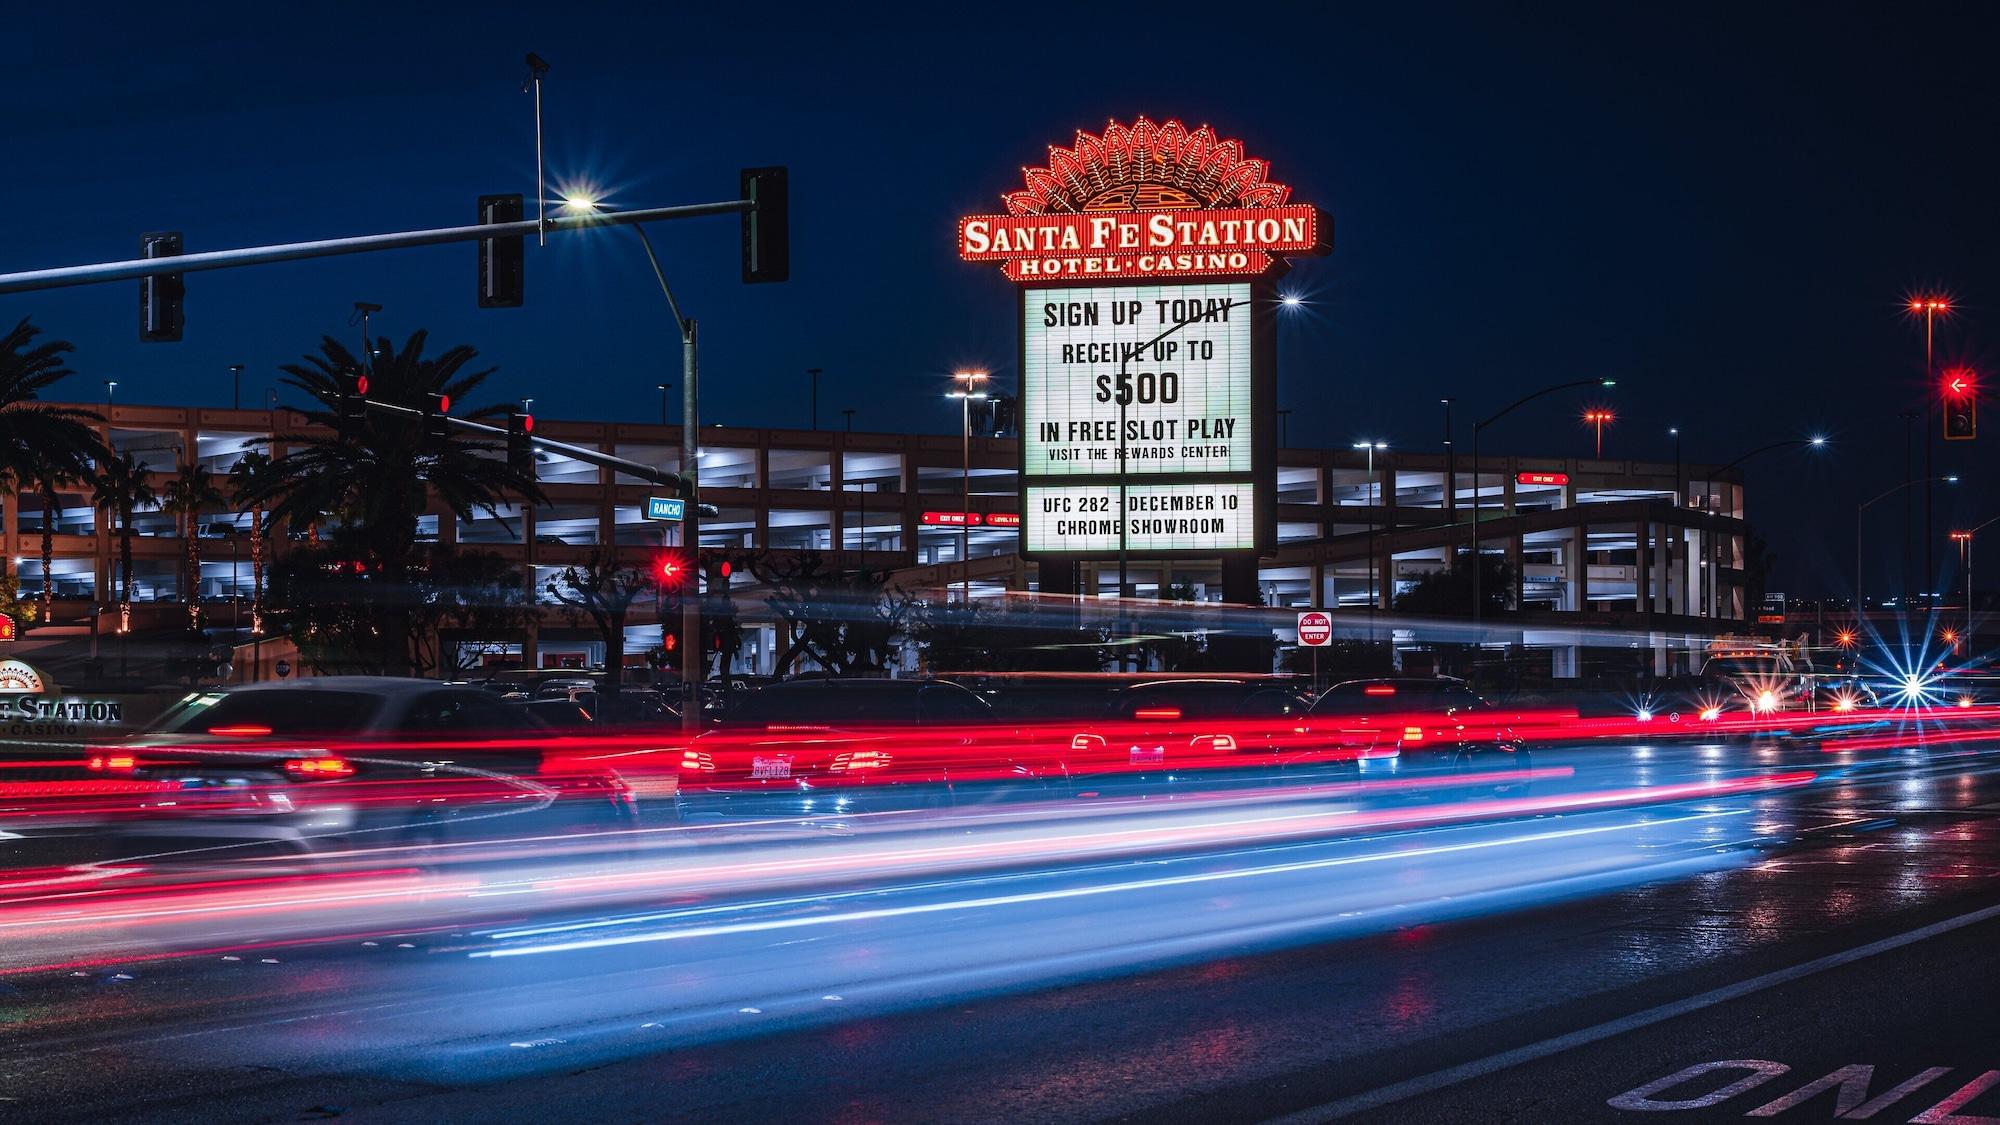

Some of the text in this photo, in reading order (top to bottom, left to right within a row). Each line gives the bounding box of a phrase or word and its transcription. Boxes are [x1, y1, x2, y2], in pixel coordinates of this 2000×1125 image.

[965, 213, 1306, 253] SANTA FE STATION
[1019, 253, 1248, 275] HOTEL CASINO
[1044, 298, 1232, 327] SIGN UP TODAY
[1062, 340, 1213, 364] RECEIVE UP TO
[1096, 372, 1178, 405] $500
[1040, 418, 1235, 442] IN FREE SLOT PLAY
[1049, 448, 1080, 461] VISIT
[1087, 448, 1108, 460] THE
[1114, 446, 1175, 460] REWARDS
[654, 503, 681, 516] RANCHO
[1043, 494, 1238, 513] UFC 282 DECEMBER 10
[1057, 518, 1225, 535] CHROME SHOWROOM
[19, 695, 122, 721] STATION
[10, 724, 77, 736] CASINO
